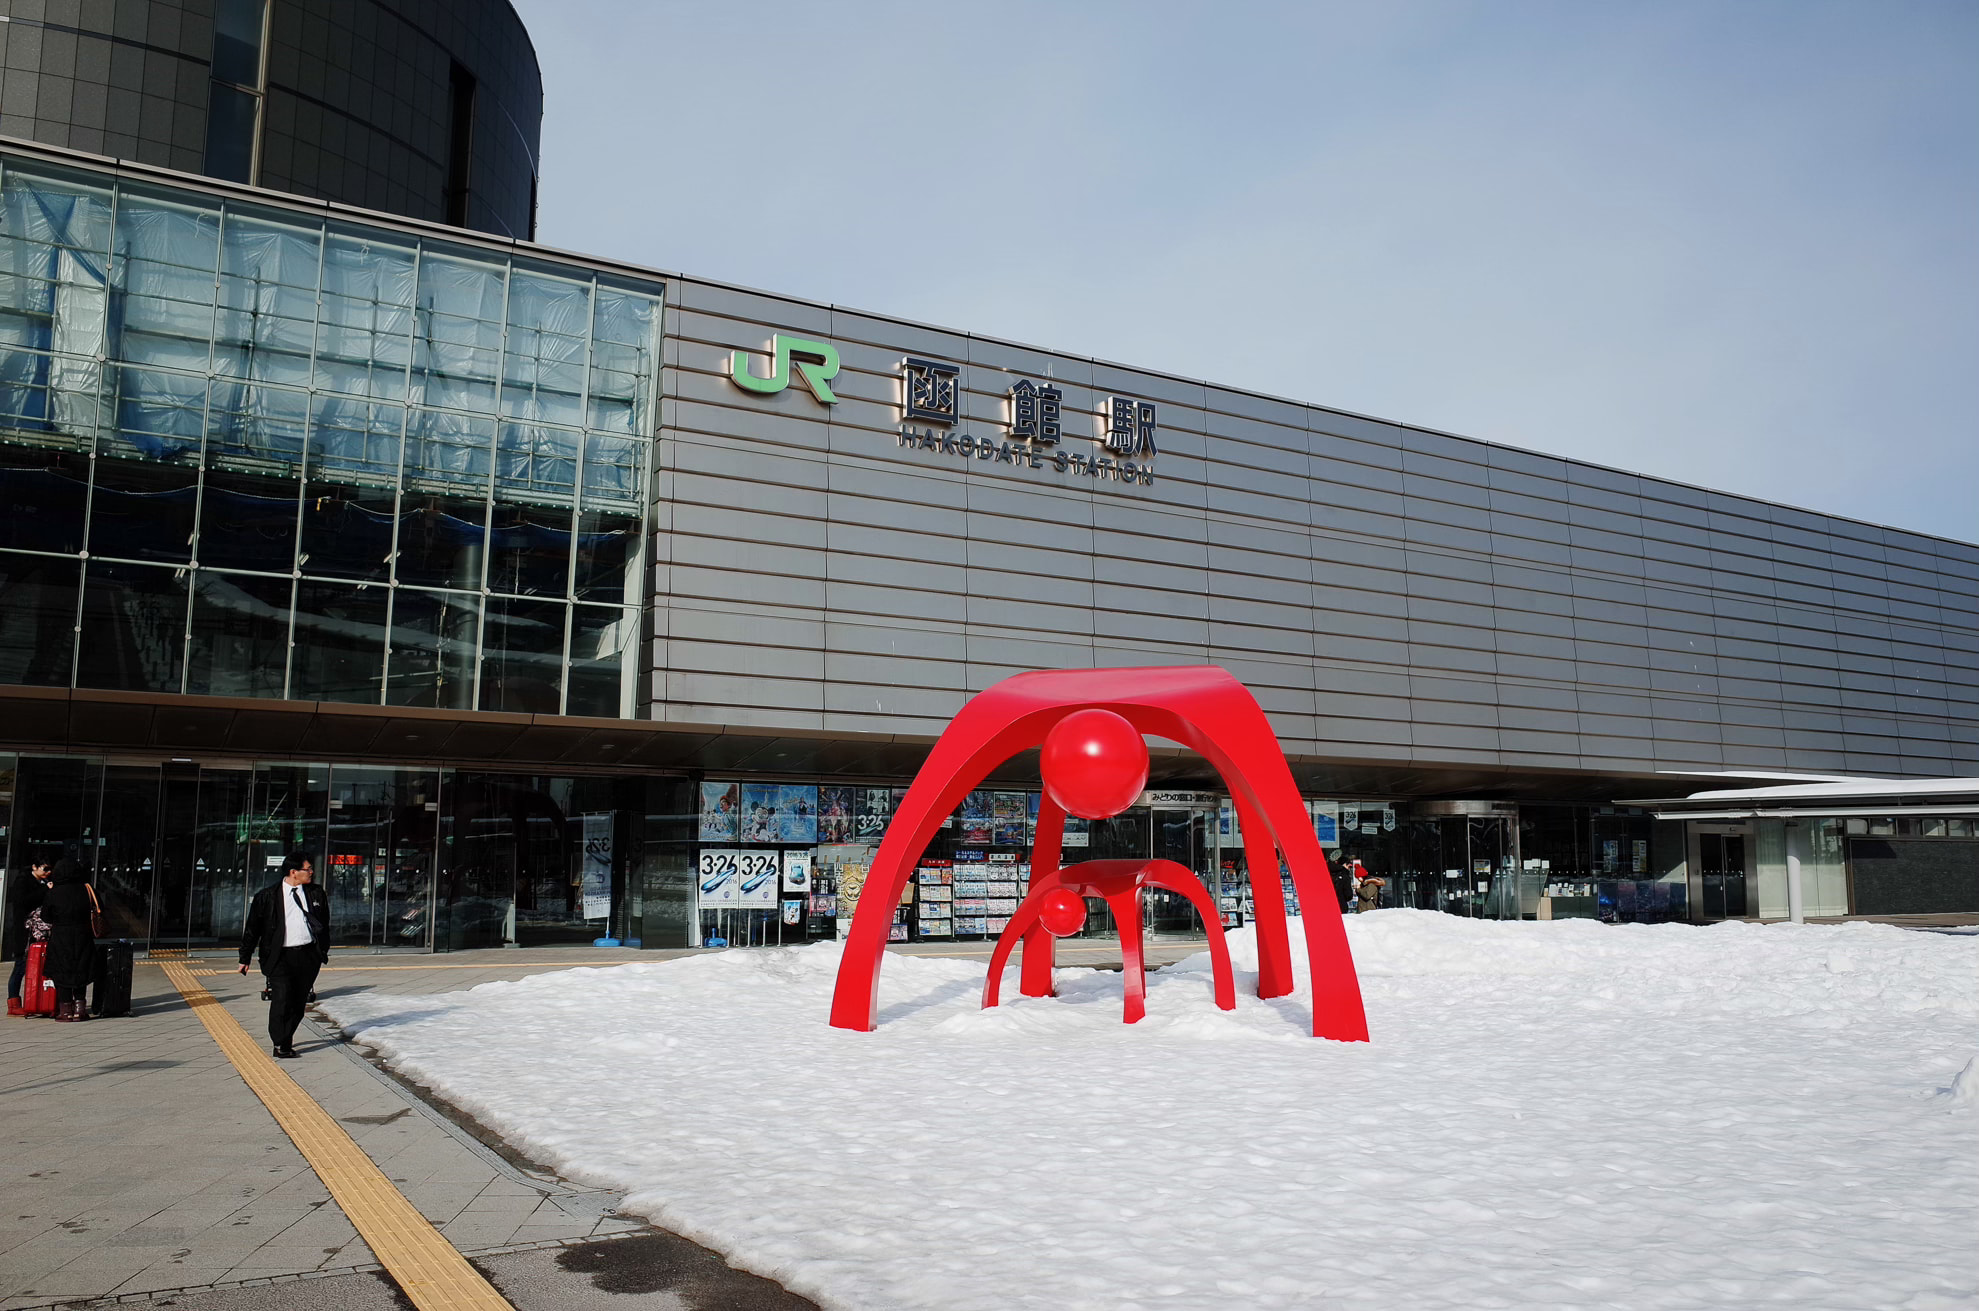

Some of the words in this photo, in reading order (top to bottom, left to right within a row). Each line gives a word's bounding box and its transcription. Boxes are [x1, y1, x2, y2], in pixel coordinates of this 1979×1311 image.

[730, 333, 840, 405] JR
[902, 356, 1159, 458] 函館駅
[899, 423, 1044, 469] HAKODATE
[1054, 451, 1155, 486] STATION
